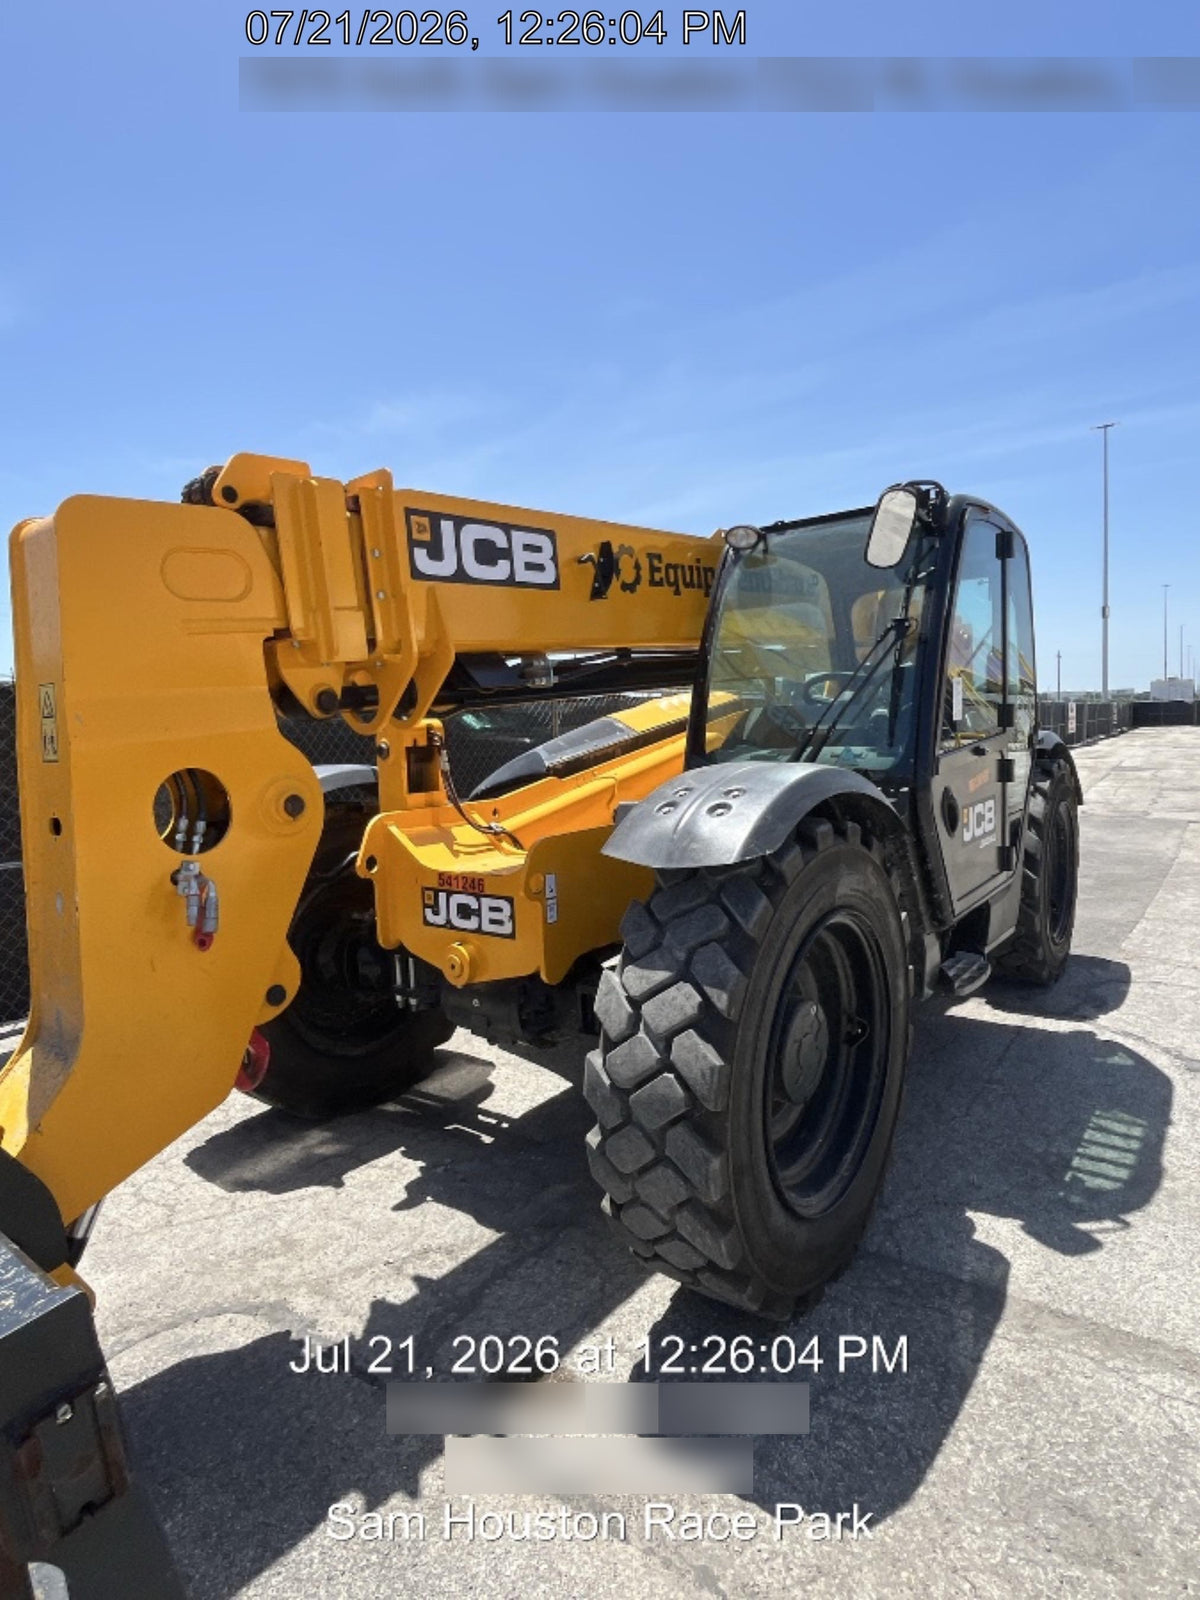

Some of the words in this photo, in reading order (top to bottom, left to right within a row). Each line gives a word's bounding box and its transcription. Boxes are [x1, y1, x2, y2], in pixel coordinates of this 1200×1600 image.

[413, 519, 557, 584] JCB
[963, 799, 995, 842] JCB
[438, 872, 485, 893] 541246
[425, 891, 513, 935] JCB
